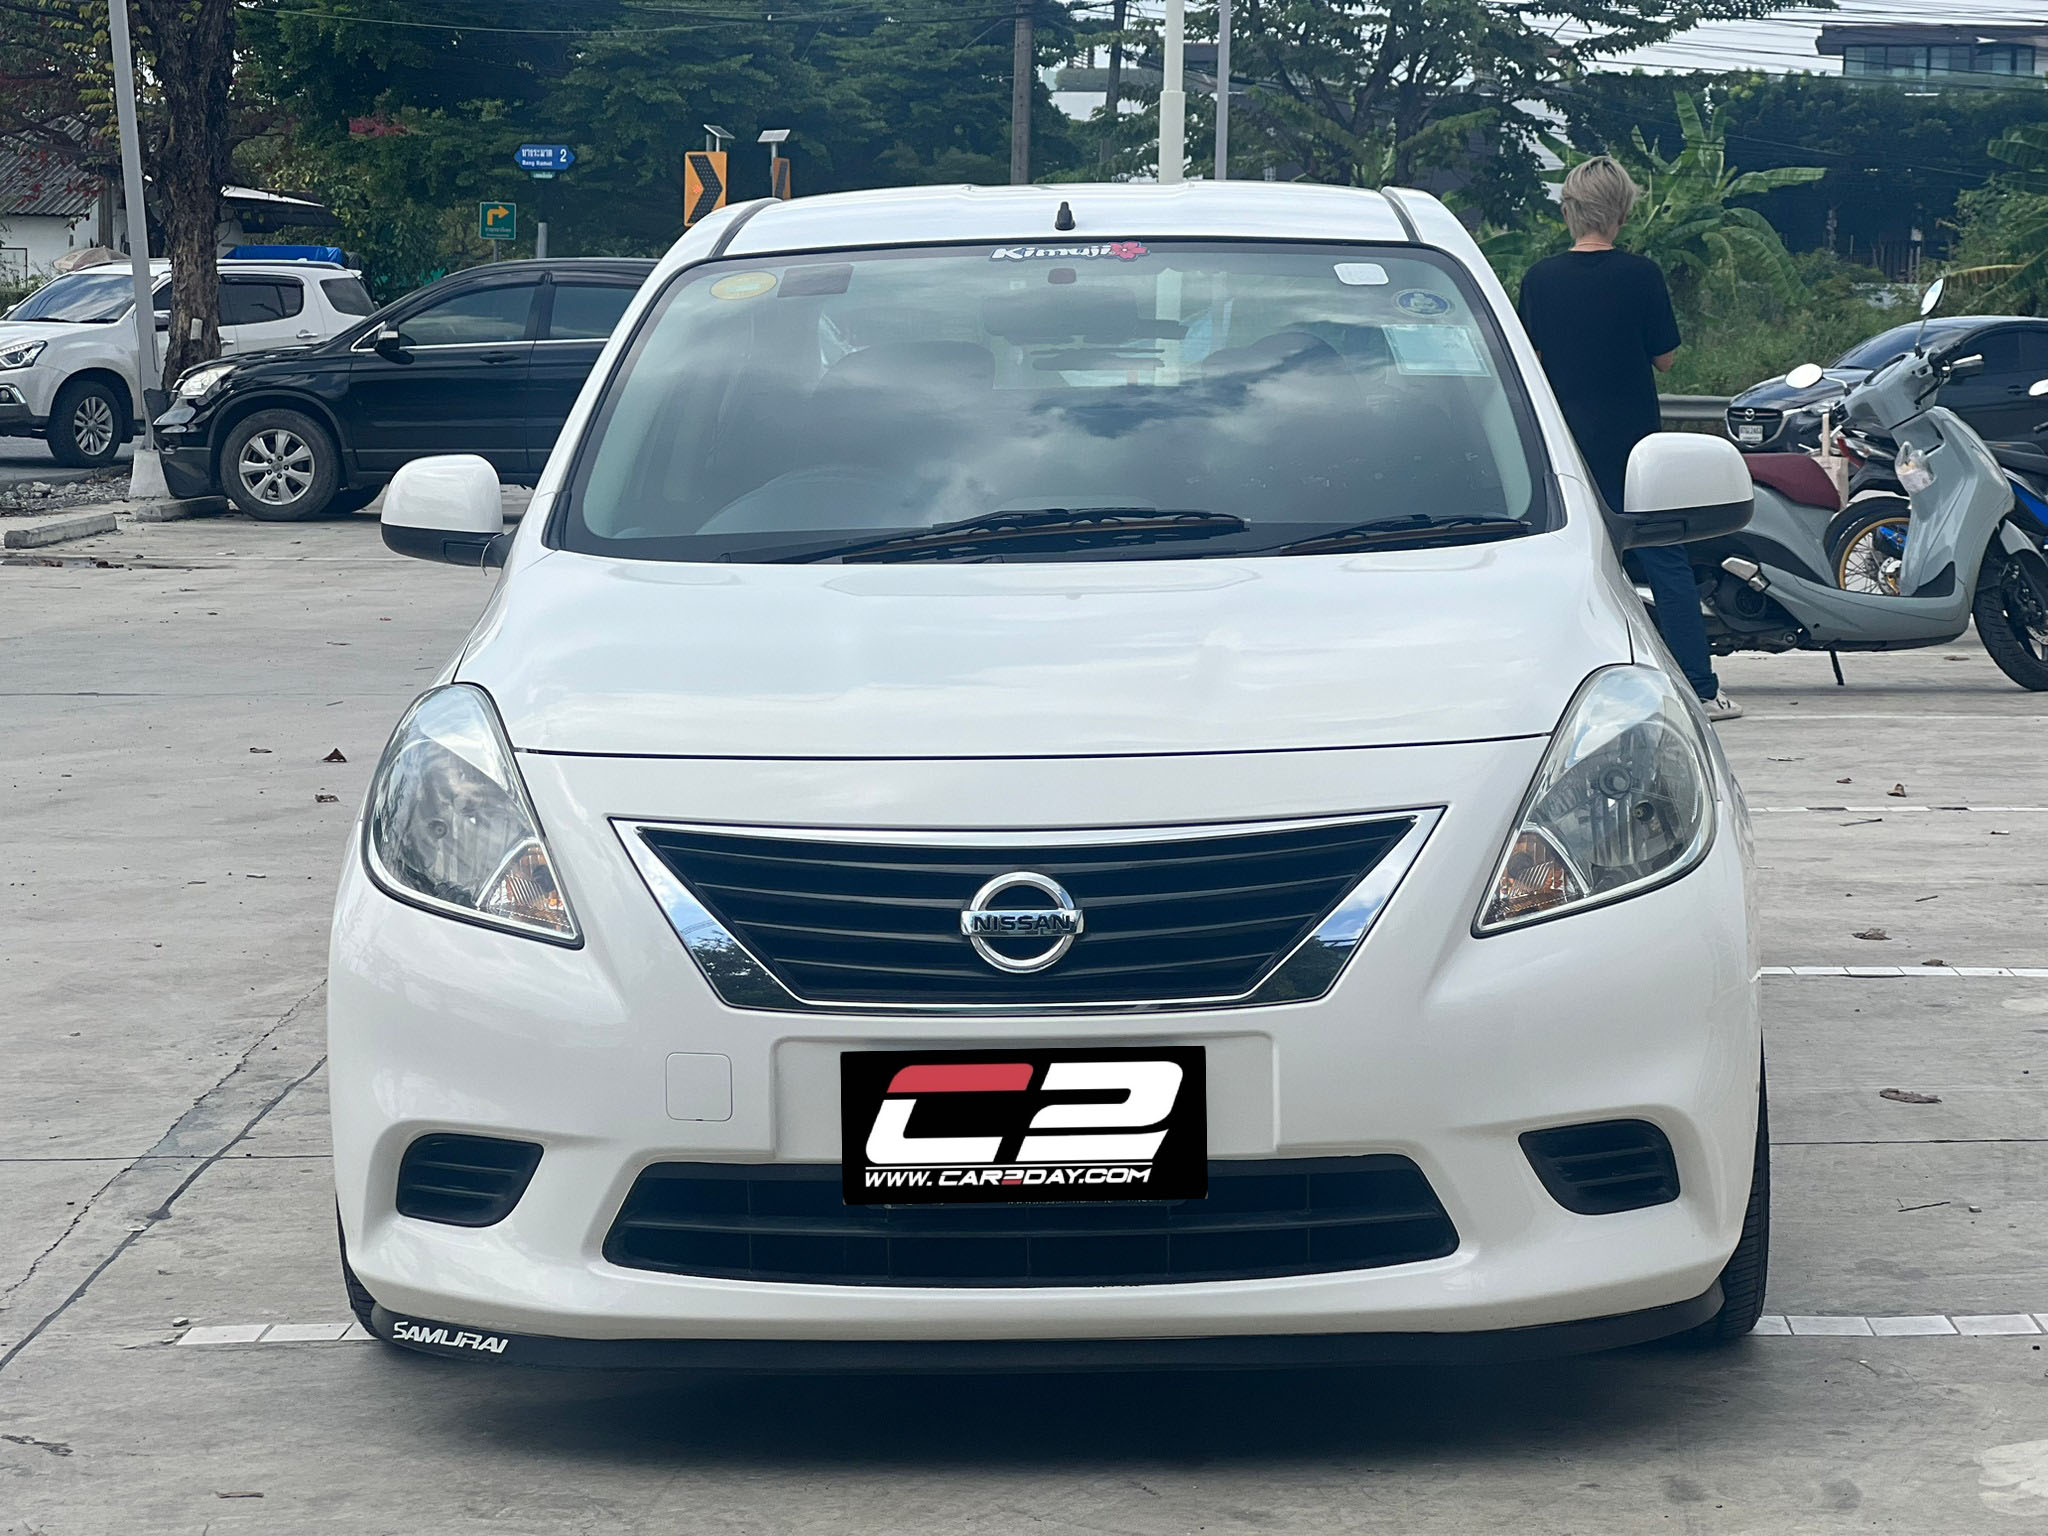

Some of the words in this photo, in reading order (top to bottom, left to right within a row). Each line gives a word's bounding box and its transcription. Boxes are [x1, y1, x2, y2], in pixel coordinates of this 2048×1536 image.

[560, 148, 567, 162] 2
[991, 245, 1112, 259] Kimuji
[973, 914, 1070, 932] NISSAN
[392, 1321, 509, 1354] SAMURAI
